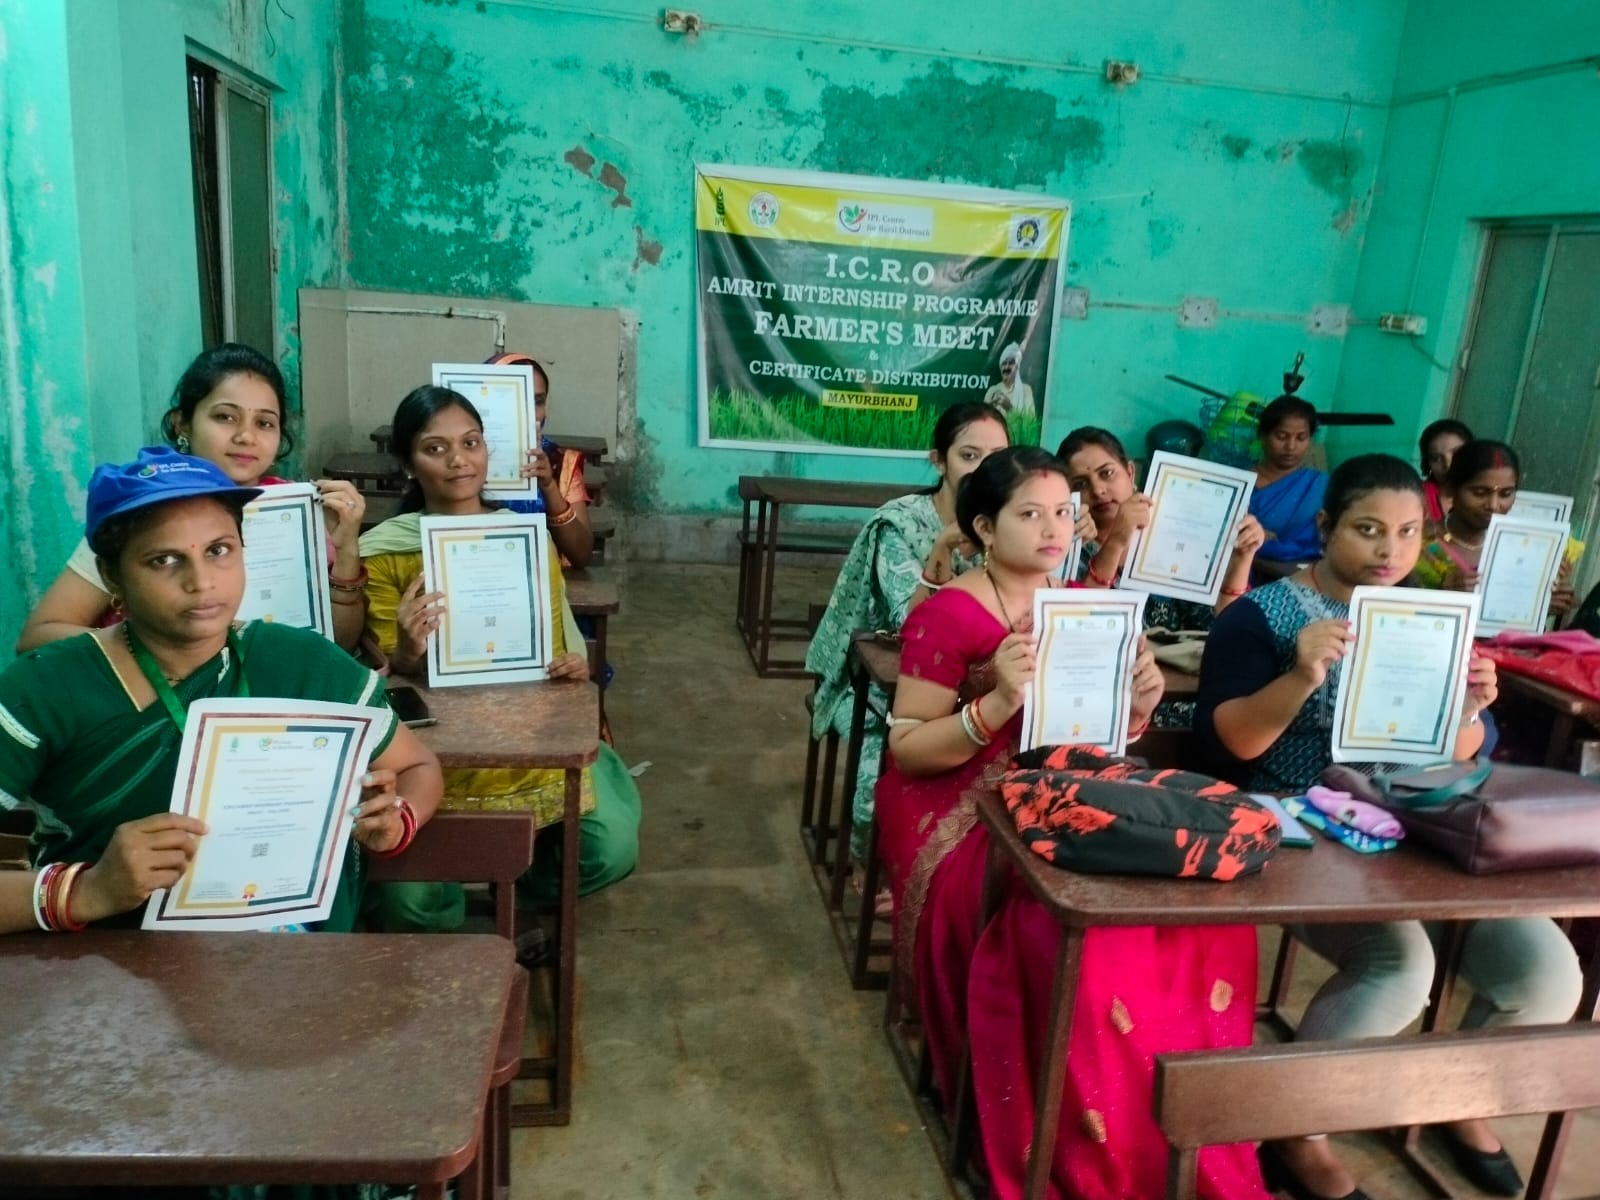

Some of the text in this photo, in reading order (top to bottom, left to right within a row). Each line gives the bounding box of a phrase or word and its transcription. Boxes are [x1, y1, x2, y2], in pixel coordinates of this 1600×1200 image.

[826, 253, 935, 286] I.C.R.O
[707, 276, 1039, 317] AMRIT INTERNSHIP PROGRAMME
[753, 311, 995, 351] FARMER'S MEET
[749, 360, 991, 390] CERTIFICATE DISTRIBUTION
[828, 392, 913, 408] MAYURBHANJ
